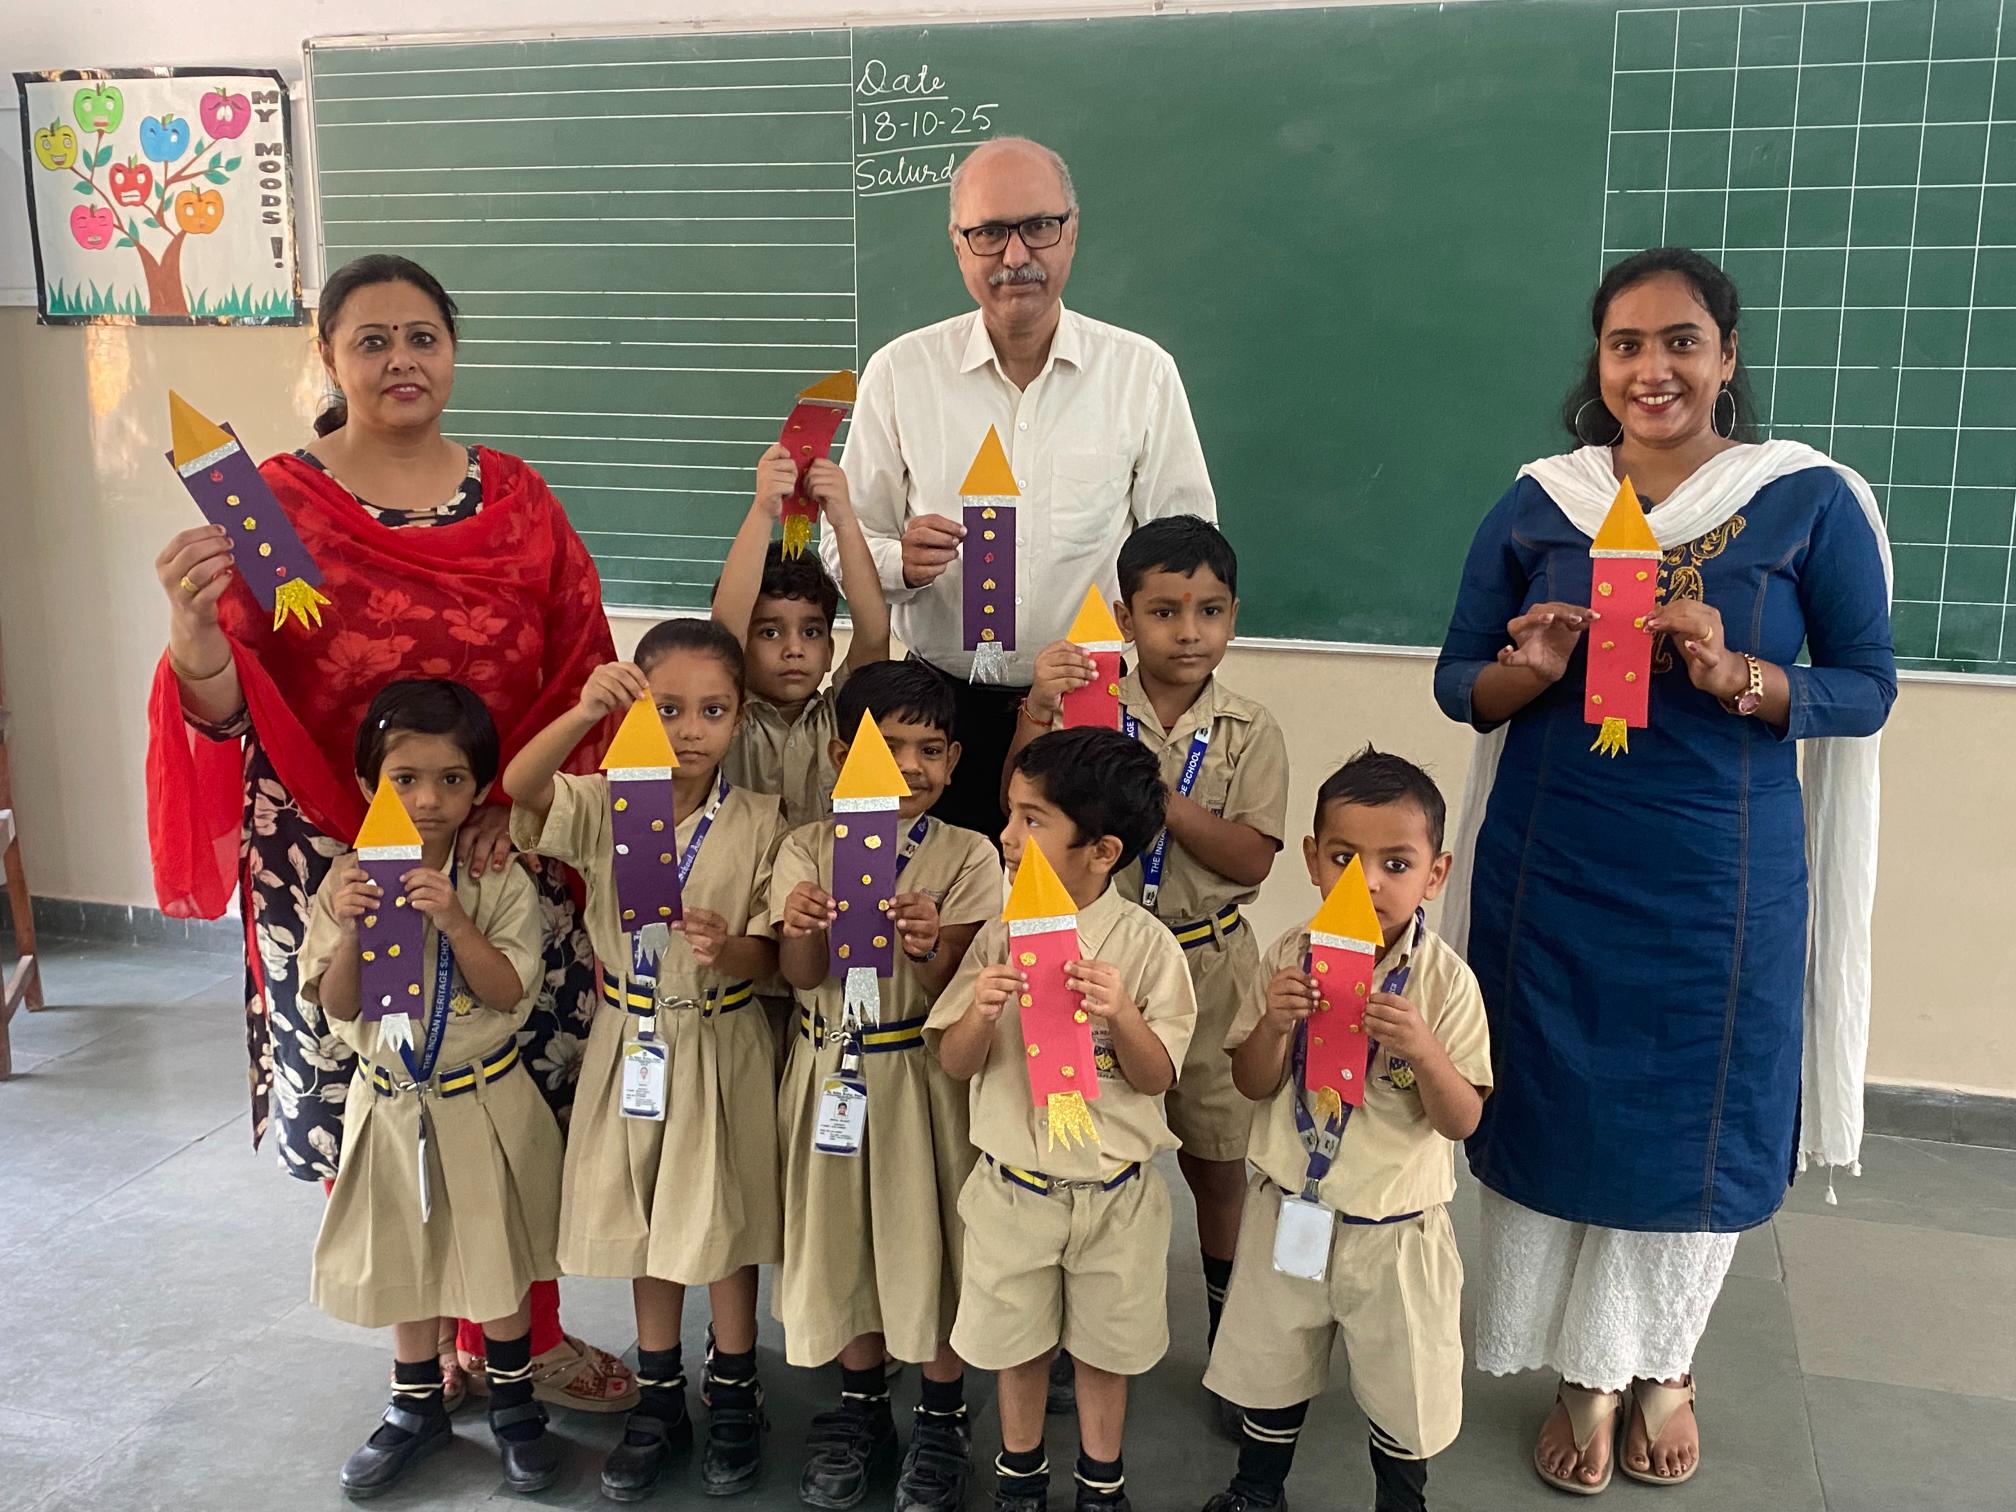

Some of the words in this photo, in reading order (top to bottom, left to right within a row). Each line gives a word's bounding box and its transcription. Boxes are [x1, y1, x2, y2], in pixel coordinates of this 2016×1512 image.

[855, 59, 946, 96] Date
[251, 90, 280, 123] MY
[862, 103, 999, 145] 18-10-25
[254, 142, 283, 225] MOODS
[855, 152, 955, 190] Saturd
[1183, 751, 1201, 785] SCHOOL
[1154, 830, 1167, 856] INDIA
[1150, 856, 1161, 874] THE
[440, 932, 450, 969] SCHOO
[434, 970, 448, 1018] HERITAGE
[426, 1019, 441, 1052] INDIAN
[422, 1052, 434, 1071] THE
